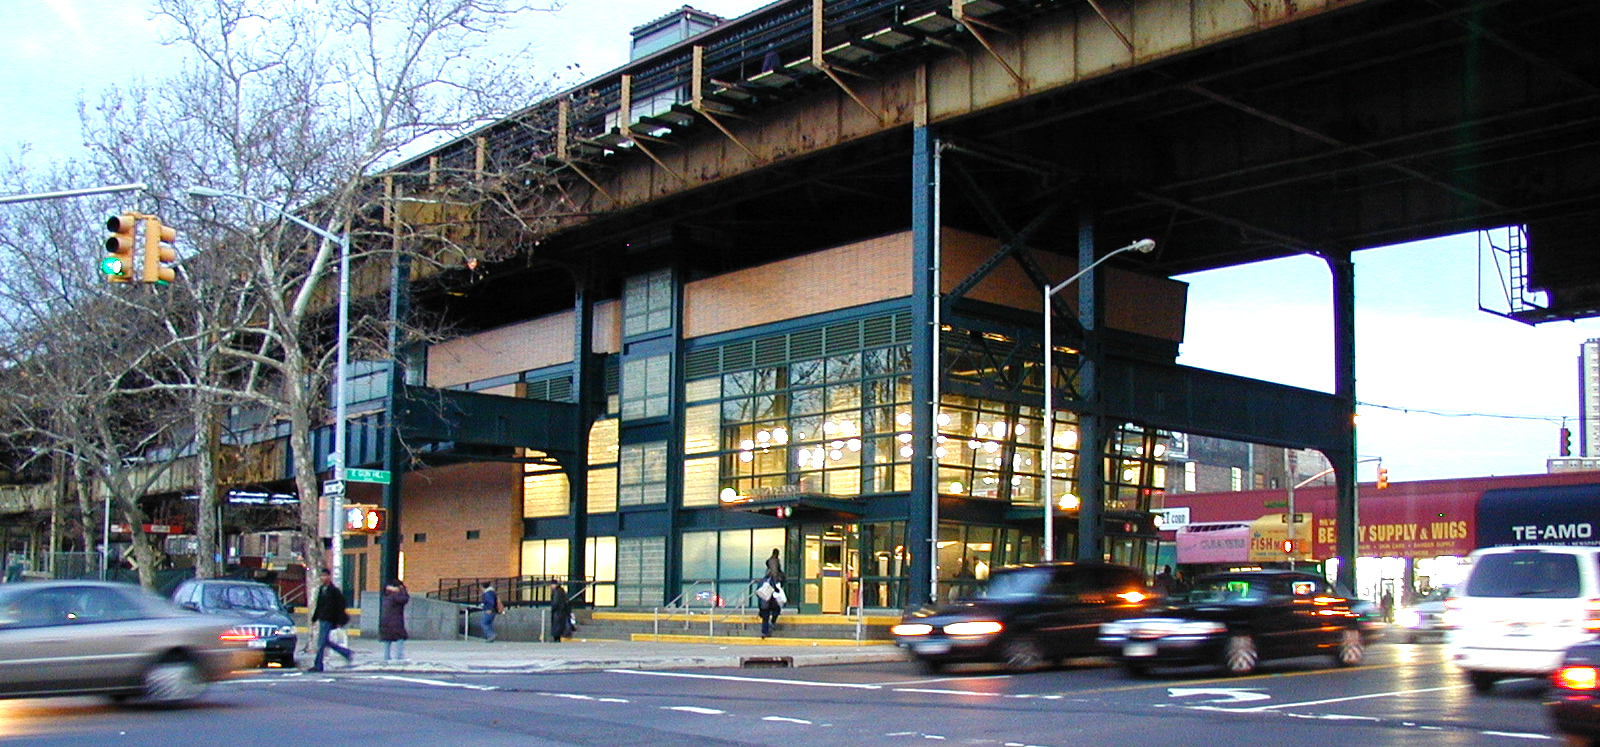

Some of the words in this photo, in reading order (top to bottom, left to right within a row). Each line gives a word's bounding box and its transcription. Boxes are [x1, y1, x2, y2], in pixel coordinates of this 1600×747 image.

[1318, 525, 1366, 543] BEY
[1369, 524, 1417, 542] SUPPLY
[1419, 527, 1428, 540] &
[1431, 521, 1467, 540] WIGS
[1512, 523, 1592, 540] TE-AMO
[1251, 538, 1272, 550] FISH
